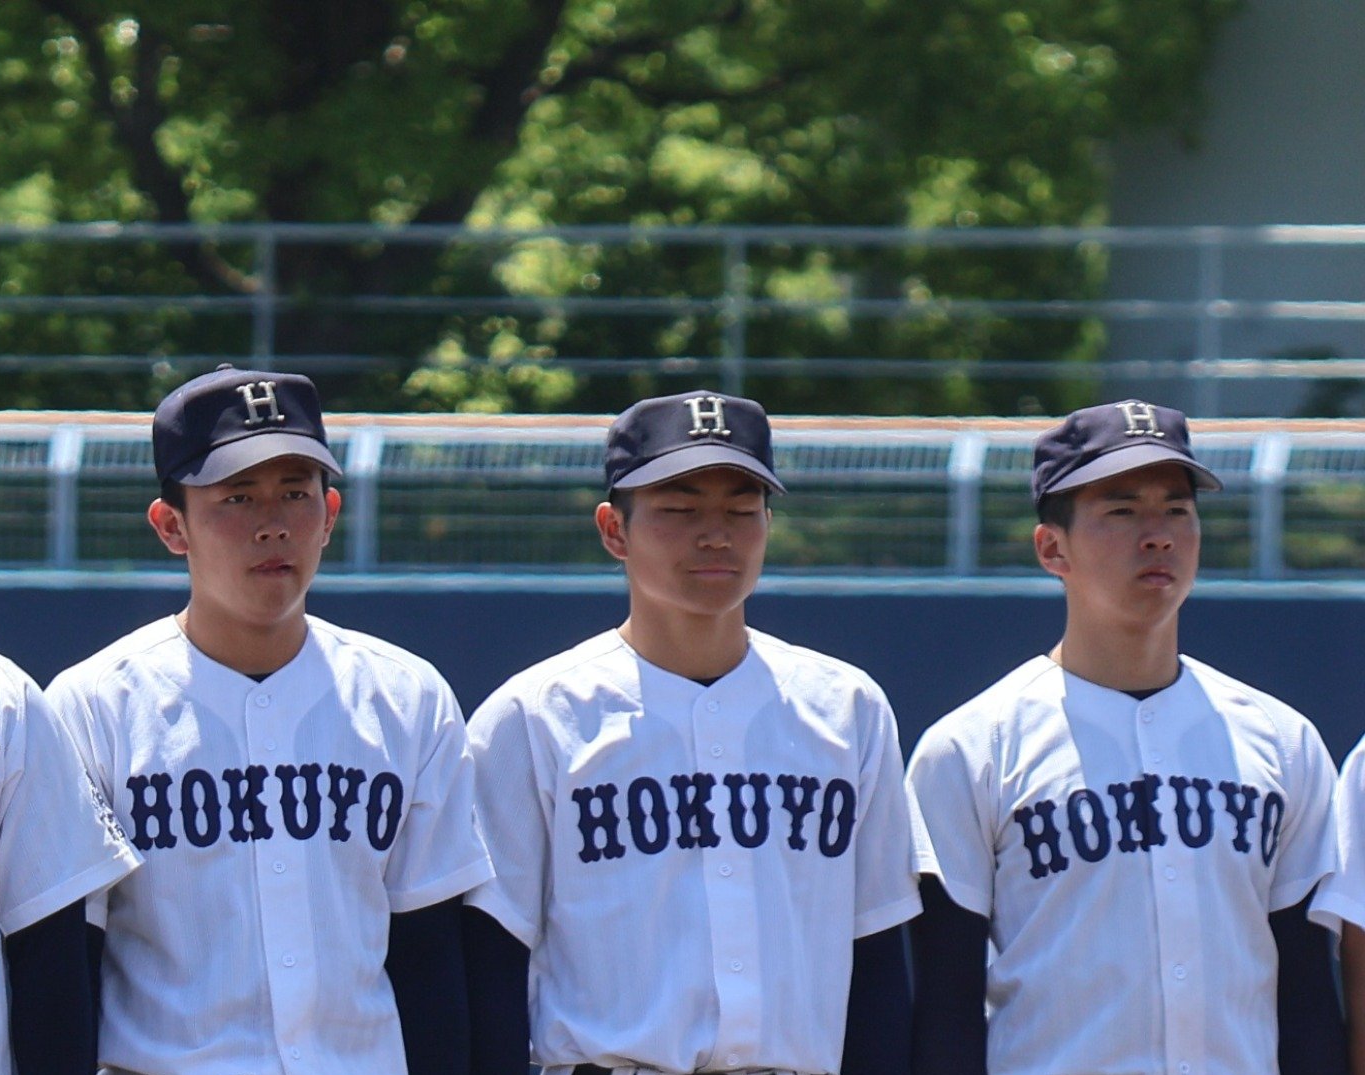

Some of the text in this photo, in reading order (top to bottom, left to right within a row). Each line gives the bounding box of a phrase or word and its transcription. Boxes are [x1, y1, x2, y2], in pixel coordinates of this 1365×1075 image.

[235, 380, 285, 425] H
[683, 396, 732, 437] H
[1115, 402, 1165, 437] H
[126, 763, 403, 852] HOKUYO
[572, 773, 856, 863] HOKUYO
[1010, 774, 1285, 880] HOKUYO
